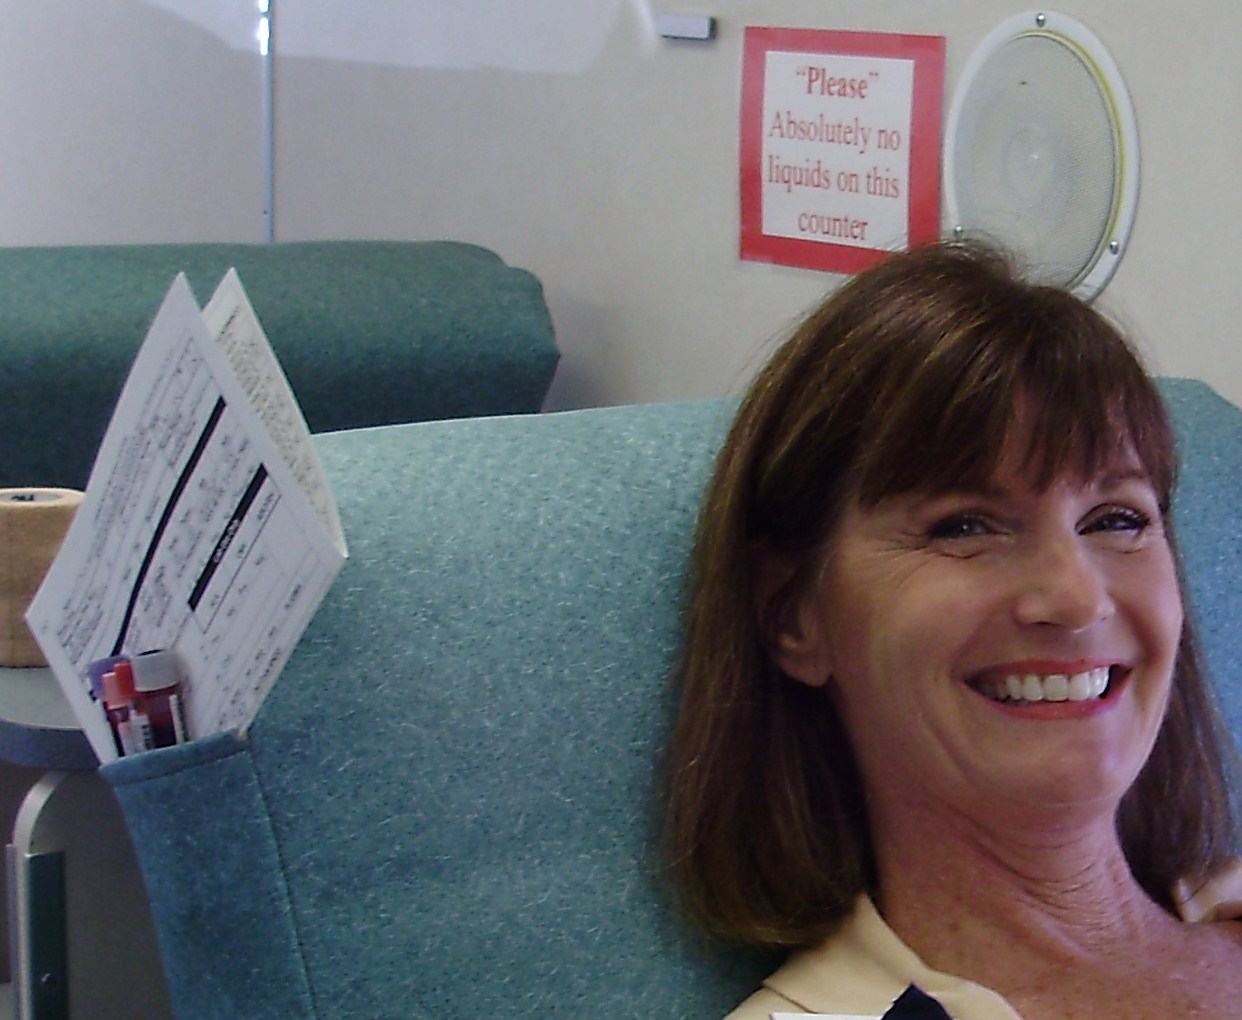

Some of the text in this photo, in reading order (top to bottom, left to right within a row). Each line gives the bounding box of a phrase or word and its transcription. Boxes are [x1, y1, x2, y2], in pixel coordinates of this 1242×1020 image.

[769, 110, 900, 155] Absolutely no
[768, 154, 899, 199] liquids on this
[798, 212, 868, 241] counter
